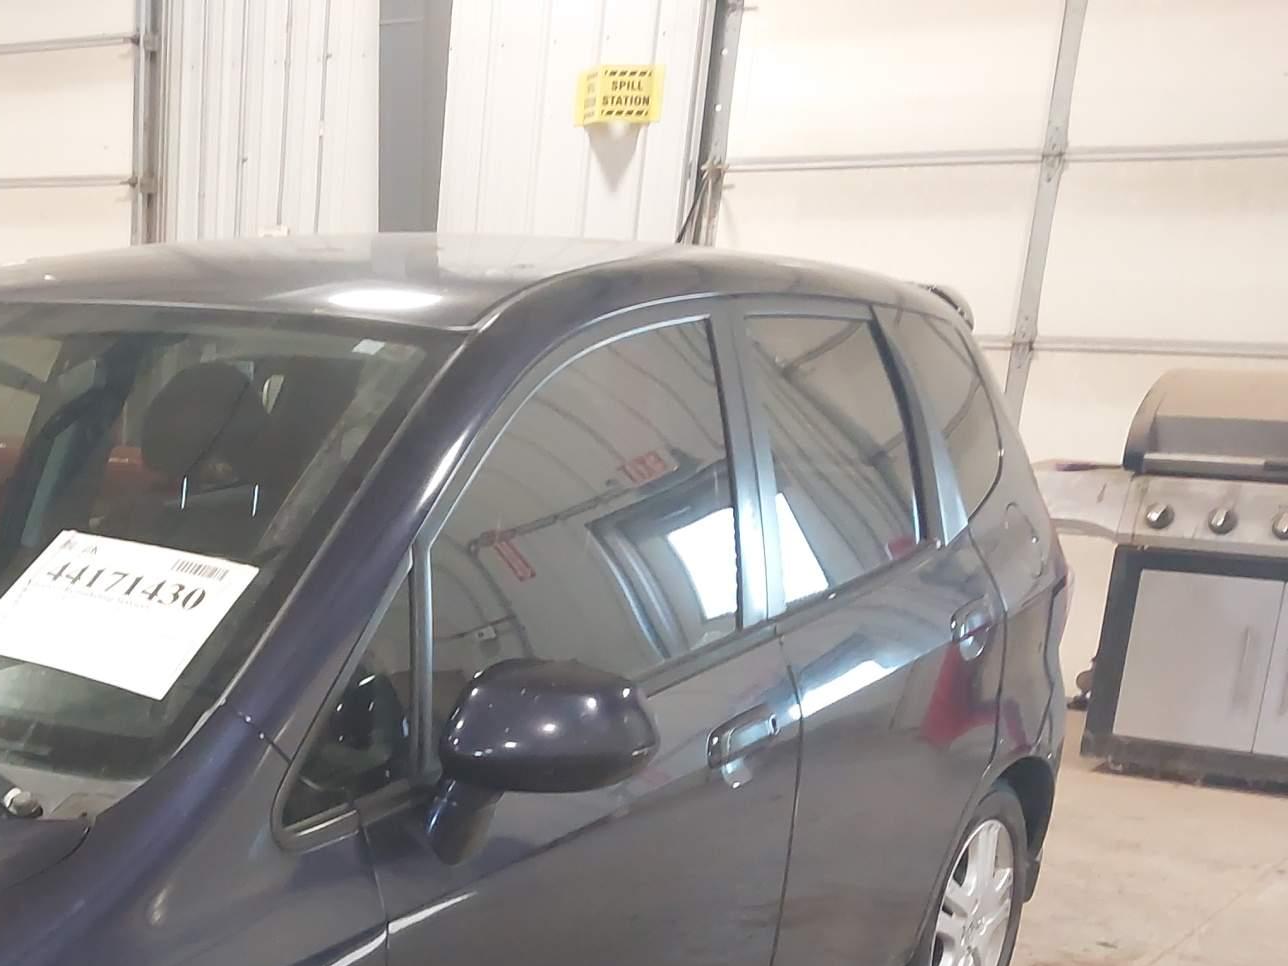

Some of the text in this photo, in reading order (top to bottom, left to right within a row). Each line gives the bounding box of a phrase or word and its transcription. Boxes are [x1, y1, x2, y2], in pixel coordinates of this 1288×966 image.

[611, 80, 643, 91] SPILL
[602, 95, 650, 106] STATION
[47, 561, 207, 611] 44171430
